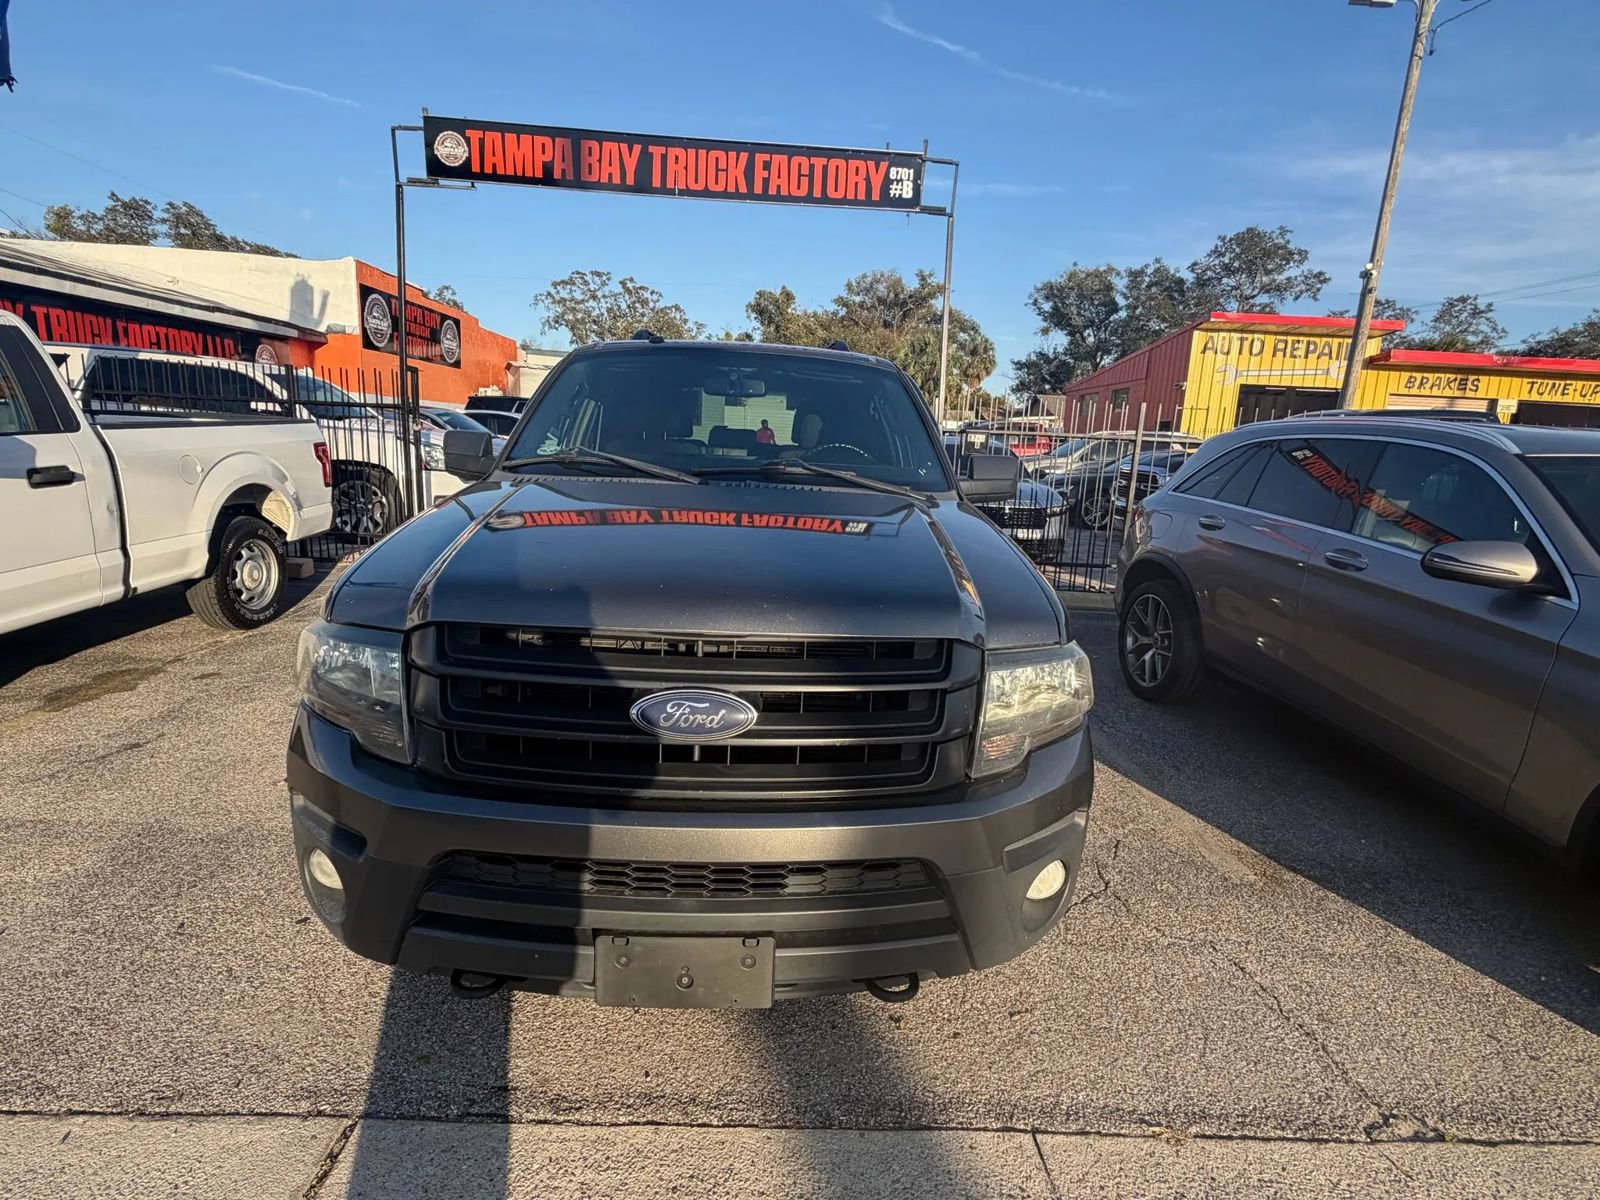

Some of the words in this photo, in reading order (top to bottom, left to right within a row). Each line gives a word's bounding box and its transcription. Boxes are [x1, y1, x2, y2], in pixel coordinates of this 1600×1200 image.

[466, 129, 574, 181] TAMPA
[580, 139, 641, 186] BAY
[648, 145, 749, 193] TRUCK
[753, 153, 889, 201] FACTORY
[889, 167, 914, 181] 8701
[889, 181, 913, 199] #B
[391, 298, 424, 324] TMPA
[30, 304, 114, 346] TRUCK
[116, 319, 203, 357] FACTORY
[1200, 335, 1265, 357] AUTO
[1404, 375, 1481, 393] BRAKES
[659, 700, 726, 729] Ford
